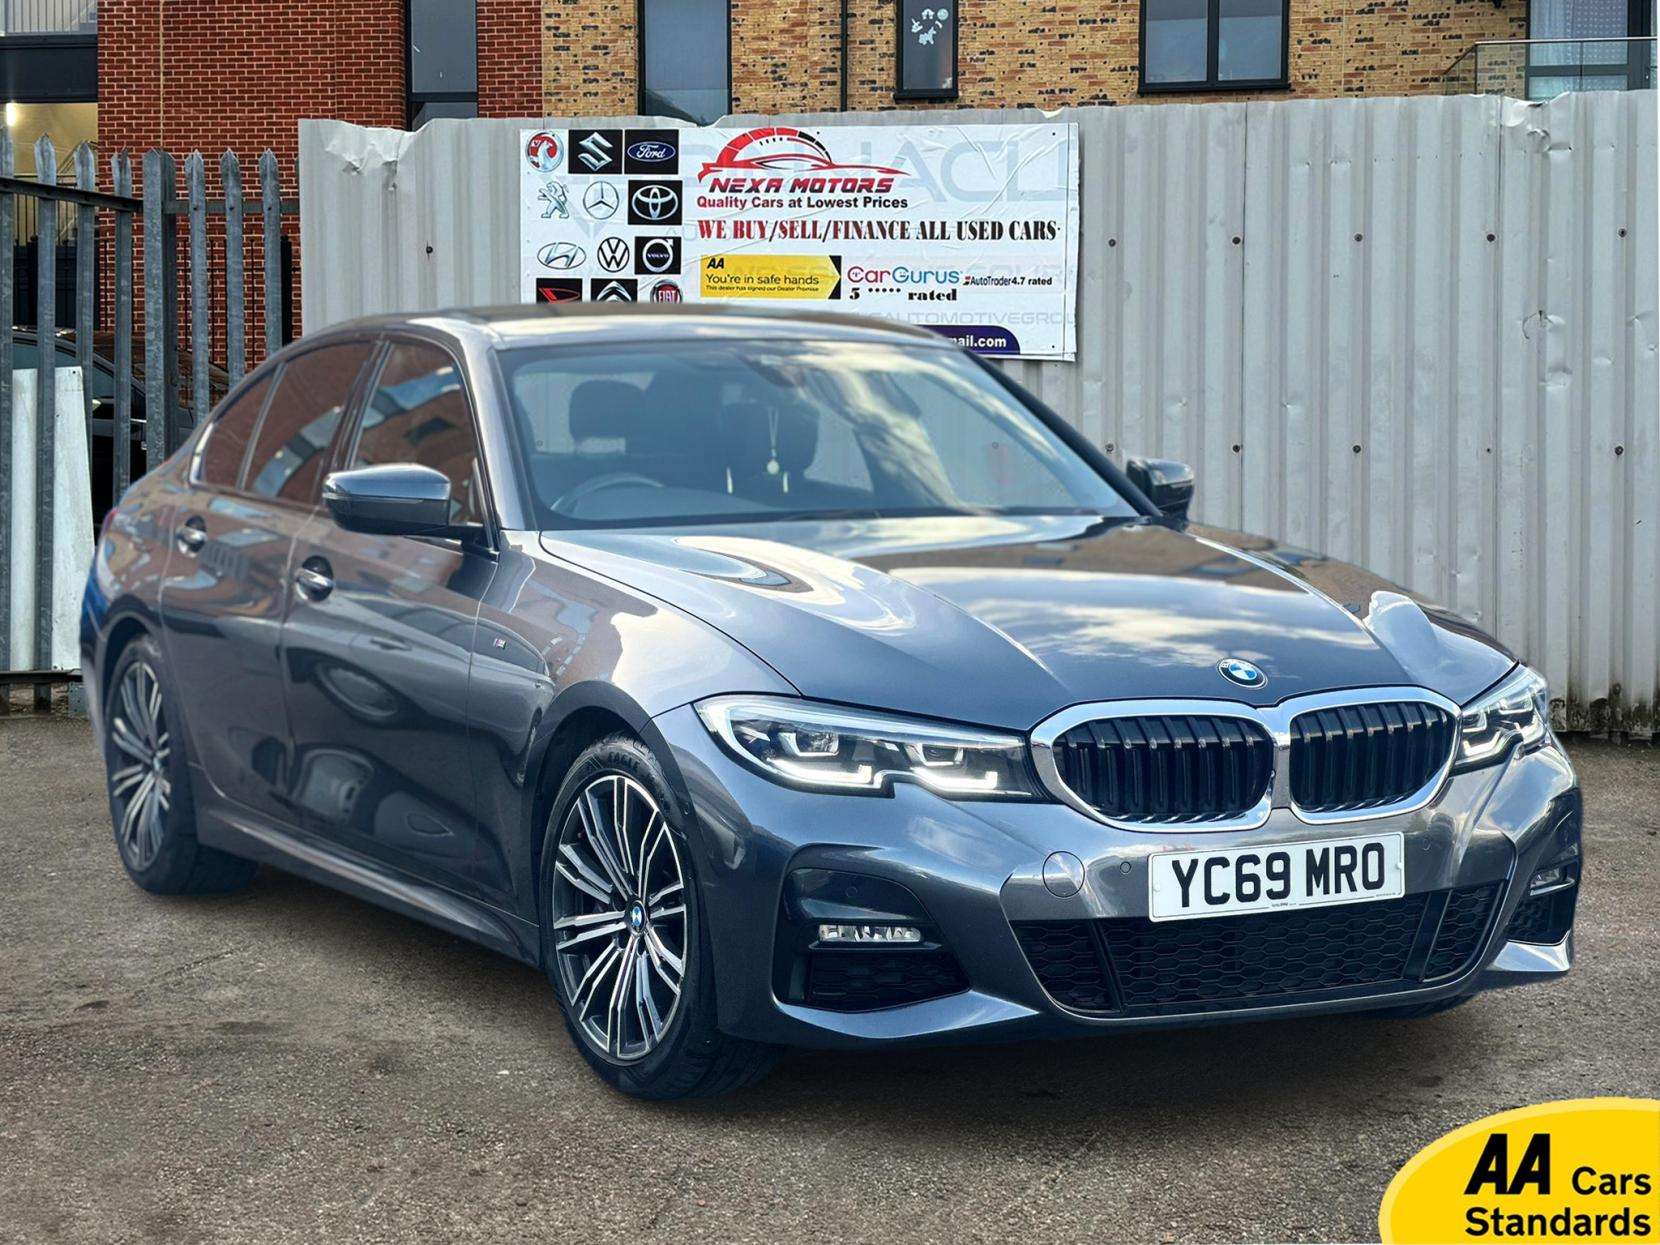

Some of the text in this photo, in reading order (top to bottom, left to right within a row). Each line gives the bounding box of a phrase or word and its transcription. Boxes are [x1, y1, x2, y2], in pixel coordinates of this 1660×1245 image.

[636, 144, 666, 158] Ford
[709, 177, 895, 193] NEXA MOTORS
[697, 196, 908, 210] Quality Cars at Lowest Prices
[697, 220, 727, 240] WE
[733, 219, 910, 243] BUY/SELL/FINANCE
[916, 220, 950, 240] ALL
[956, 220, 1004, 240] USED
[707, 257, 725, 269] AA
[706, 274, 819, 285] You're in safe hands
[847, 266, 960, 283] CarGurus
[1011, 276, 1026, 285] 4.7
[1028, 277, 1053, 285] rated
[659, 290, 678, 304] FIAT
[849, 288, 957, 300] 5 rated
[1171, 842, 1385, 907] YC69 MRO
